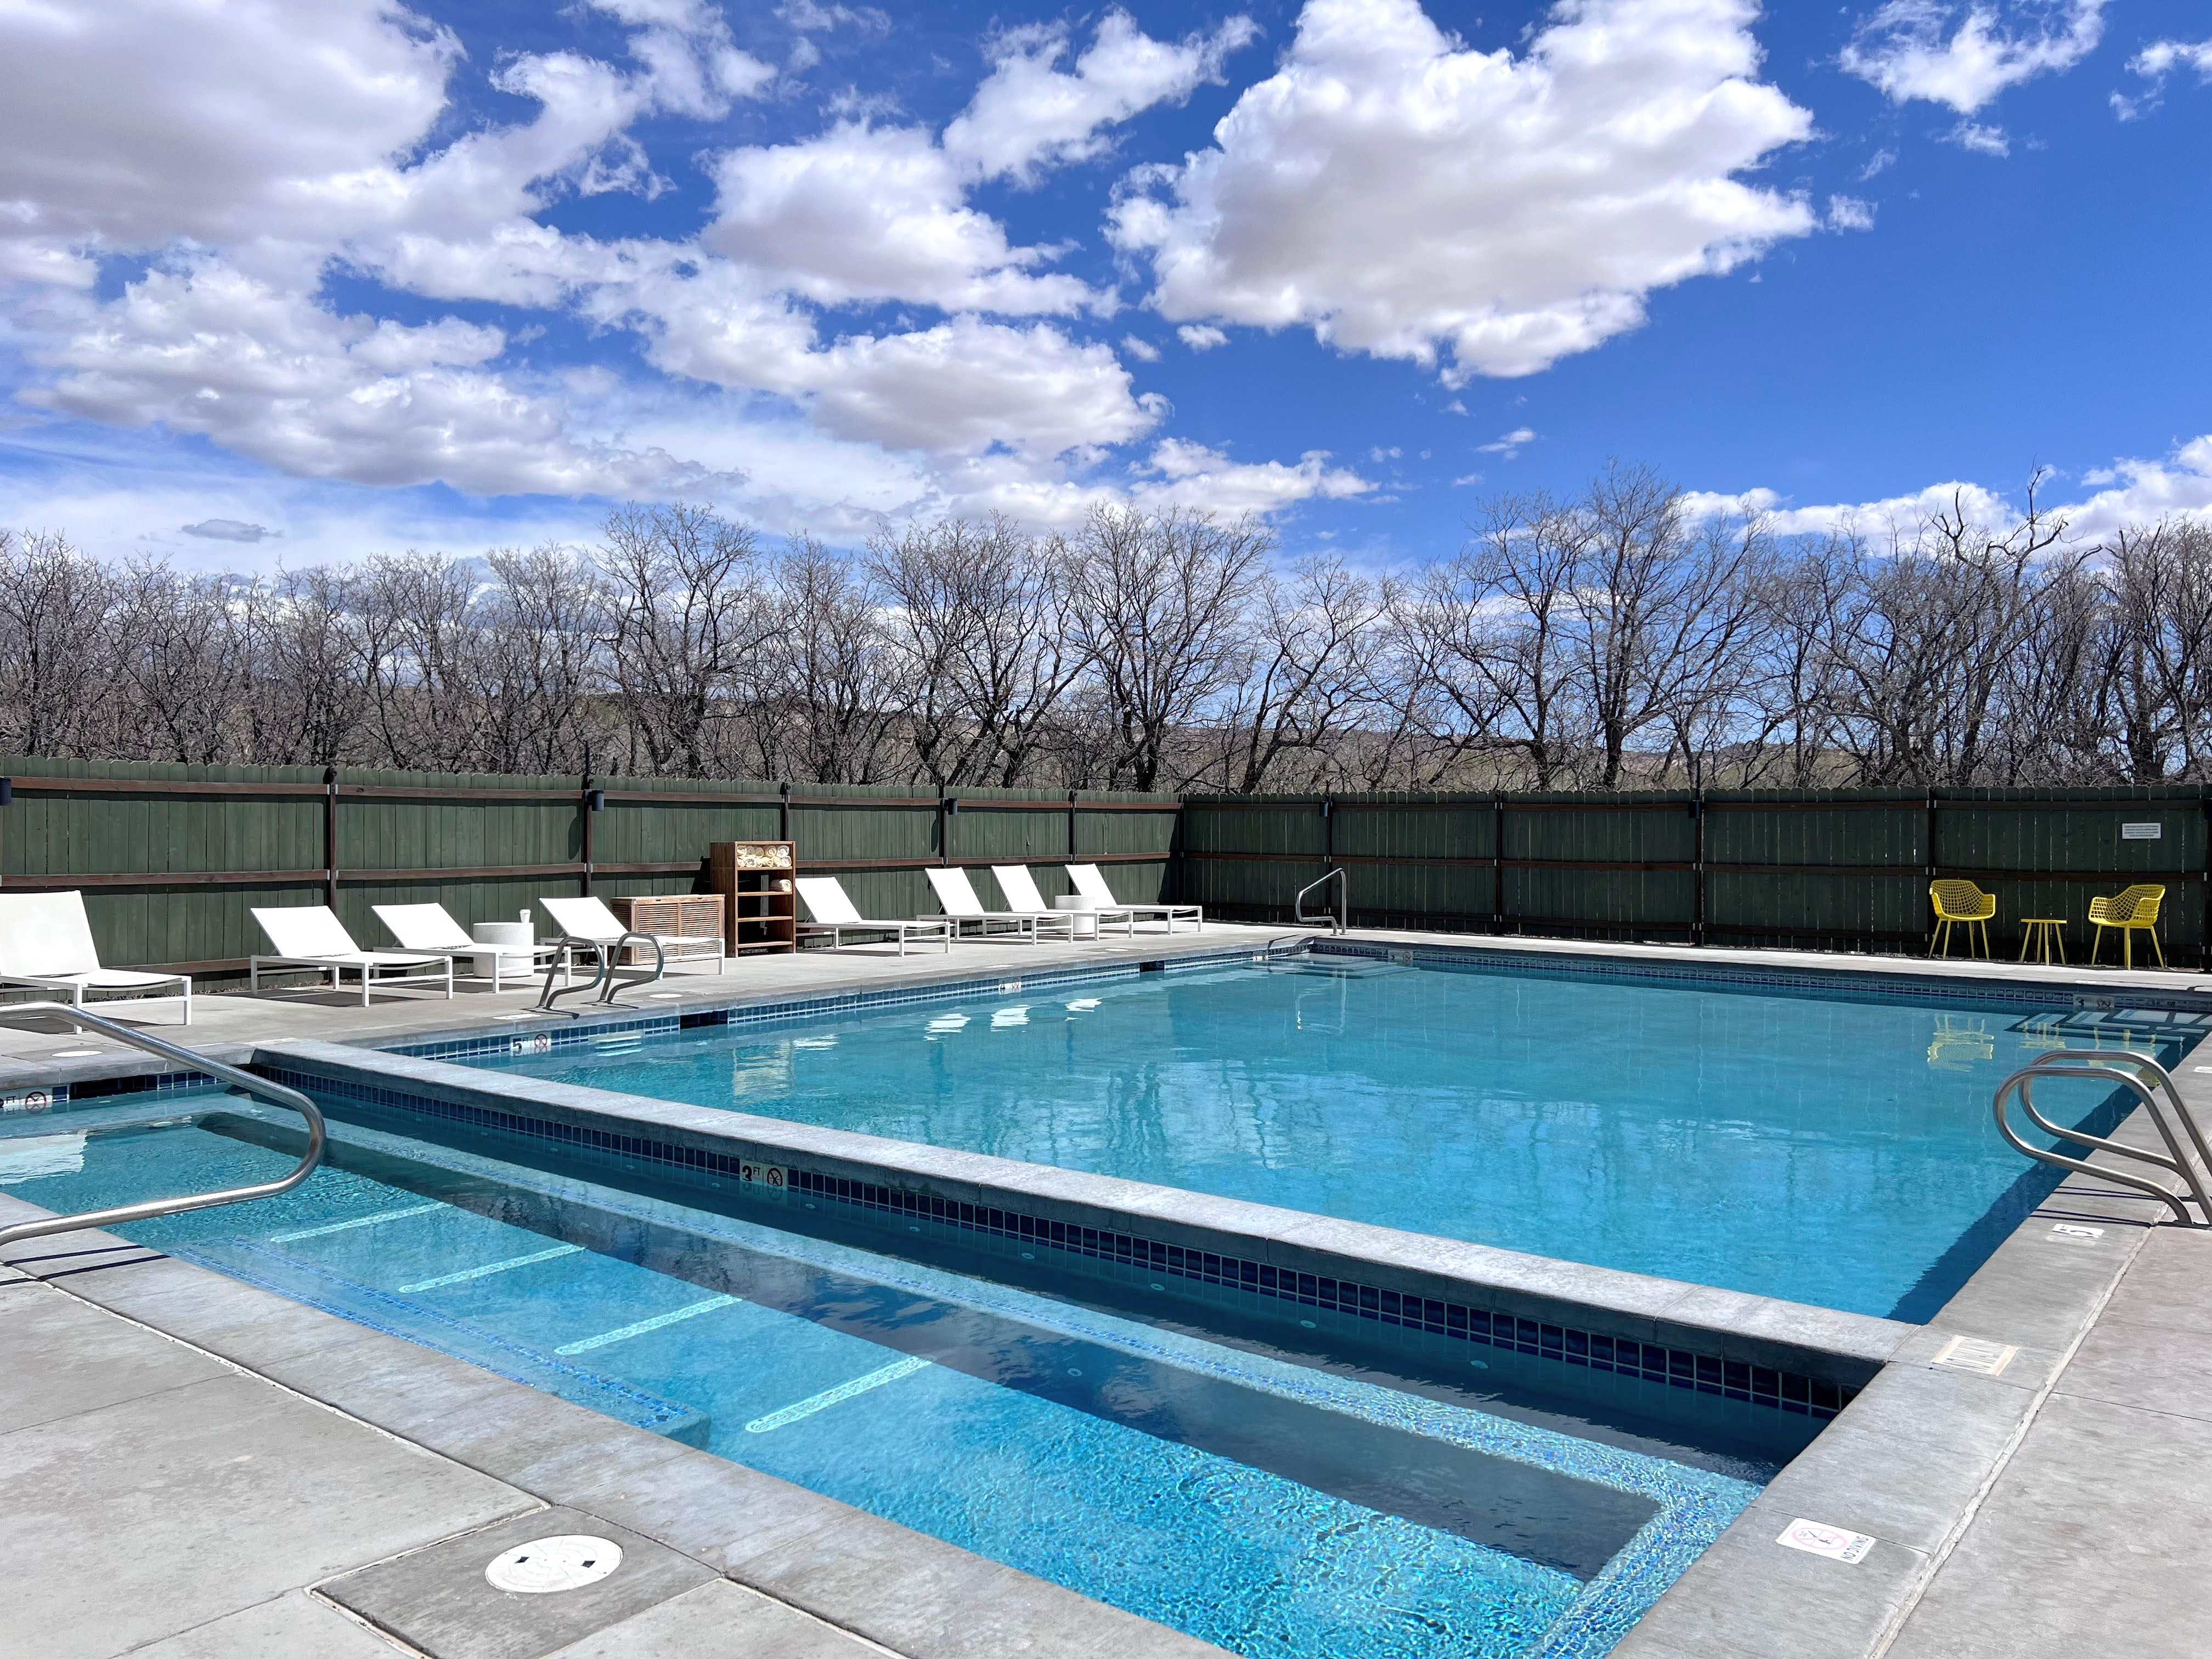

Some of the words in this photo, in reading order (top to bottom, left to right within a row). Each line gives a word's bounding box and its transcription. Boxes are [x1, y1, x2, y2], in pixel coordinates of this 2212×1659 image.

[513, 1037, 522, 1049] 5
[7, 1096, 16, 1104] FT
[753, 1166, 761, 1176] FT
[1846, 1536, 1869, 1553] DIVING
[1840, 1551, 1857, 1561] NO
